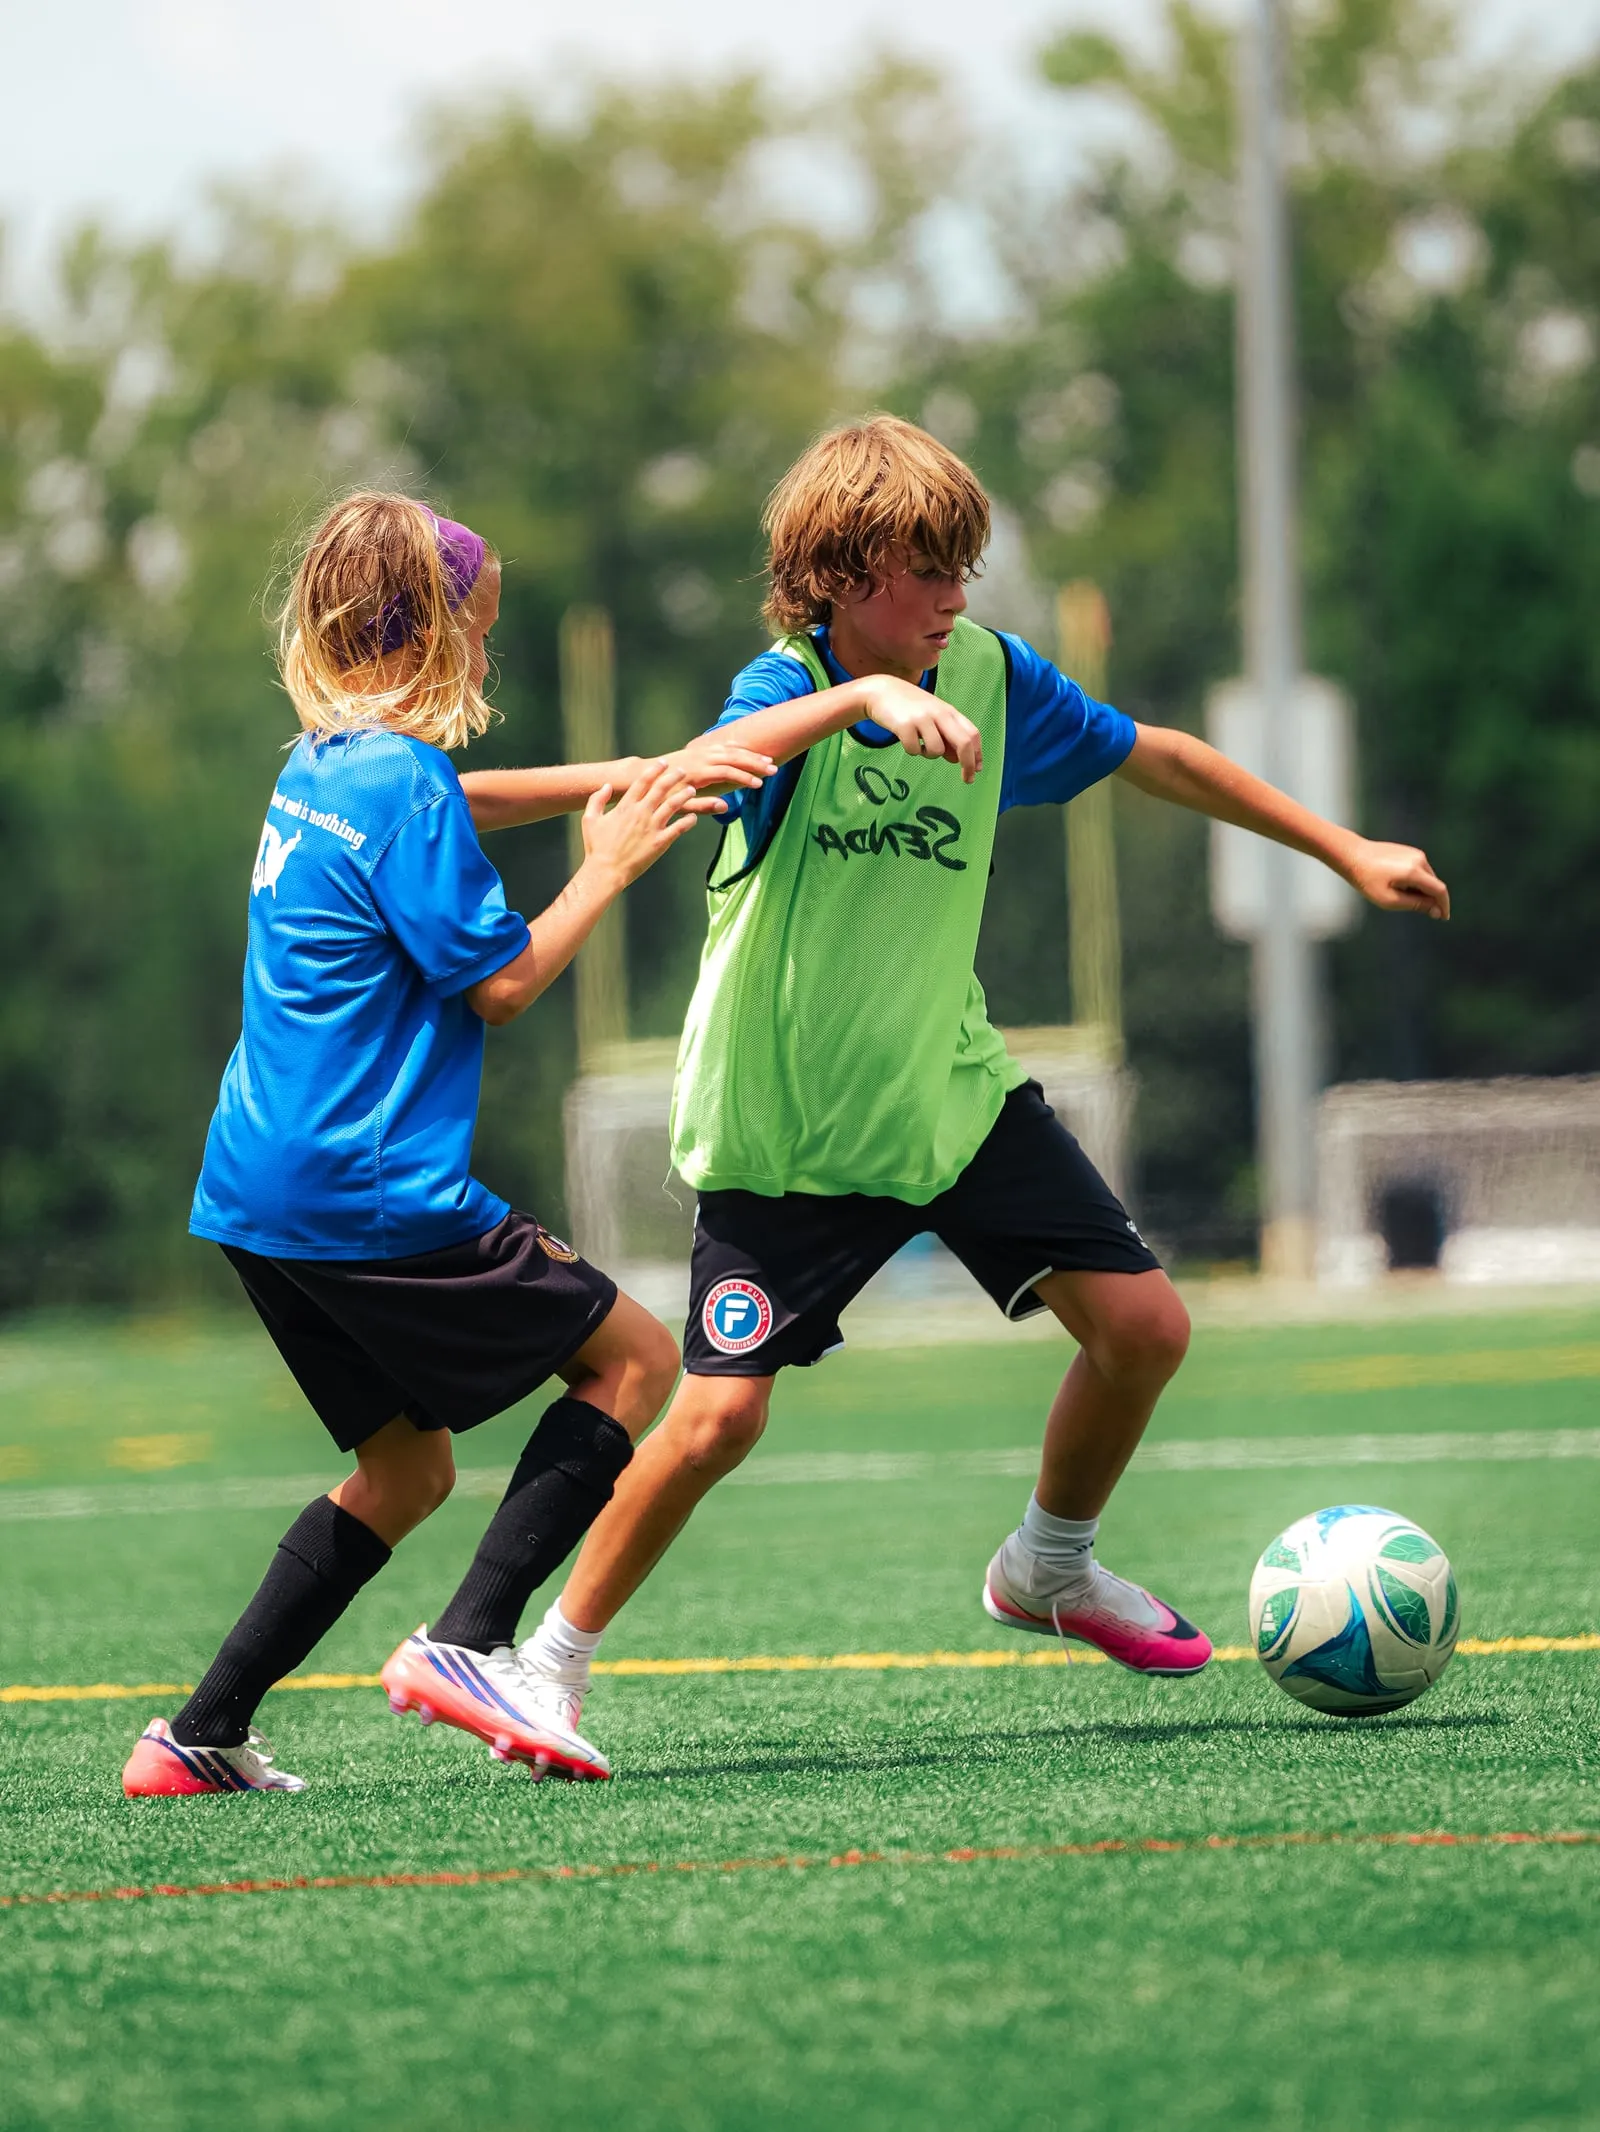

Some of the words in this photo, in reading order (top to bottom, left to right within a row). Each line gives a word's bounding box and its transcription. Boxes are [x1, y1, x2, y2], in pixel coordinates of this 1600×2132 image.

[308, 809, 367, 851] nothing
[711, 1283, 743, 1301] YOUTH
[746, 1286, 769, 1322] FUTSAL
[723, 1298, 750, 1334] F
